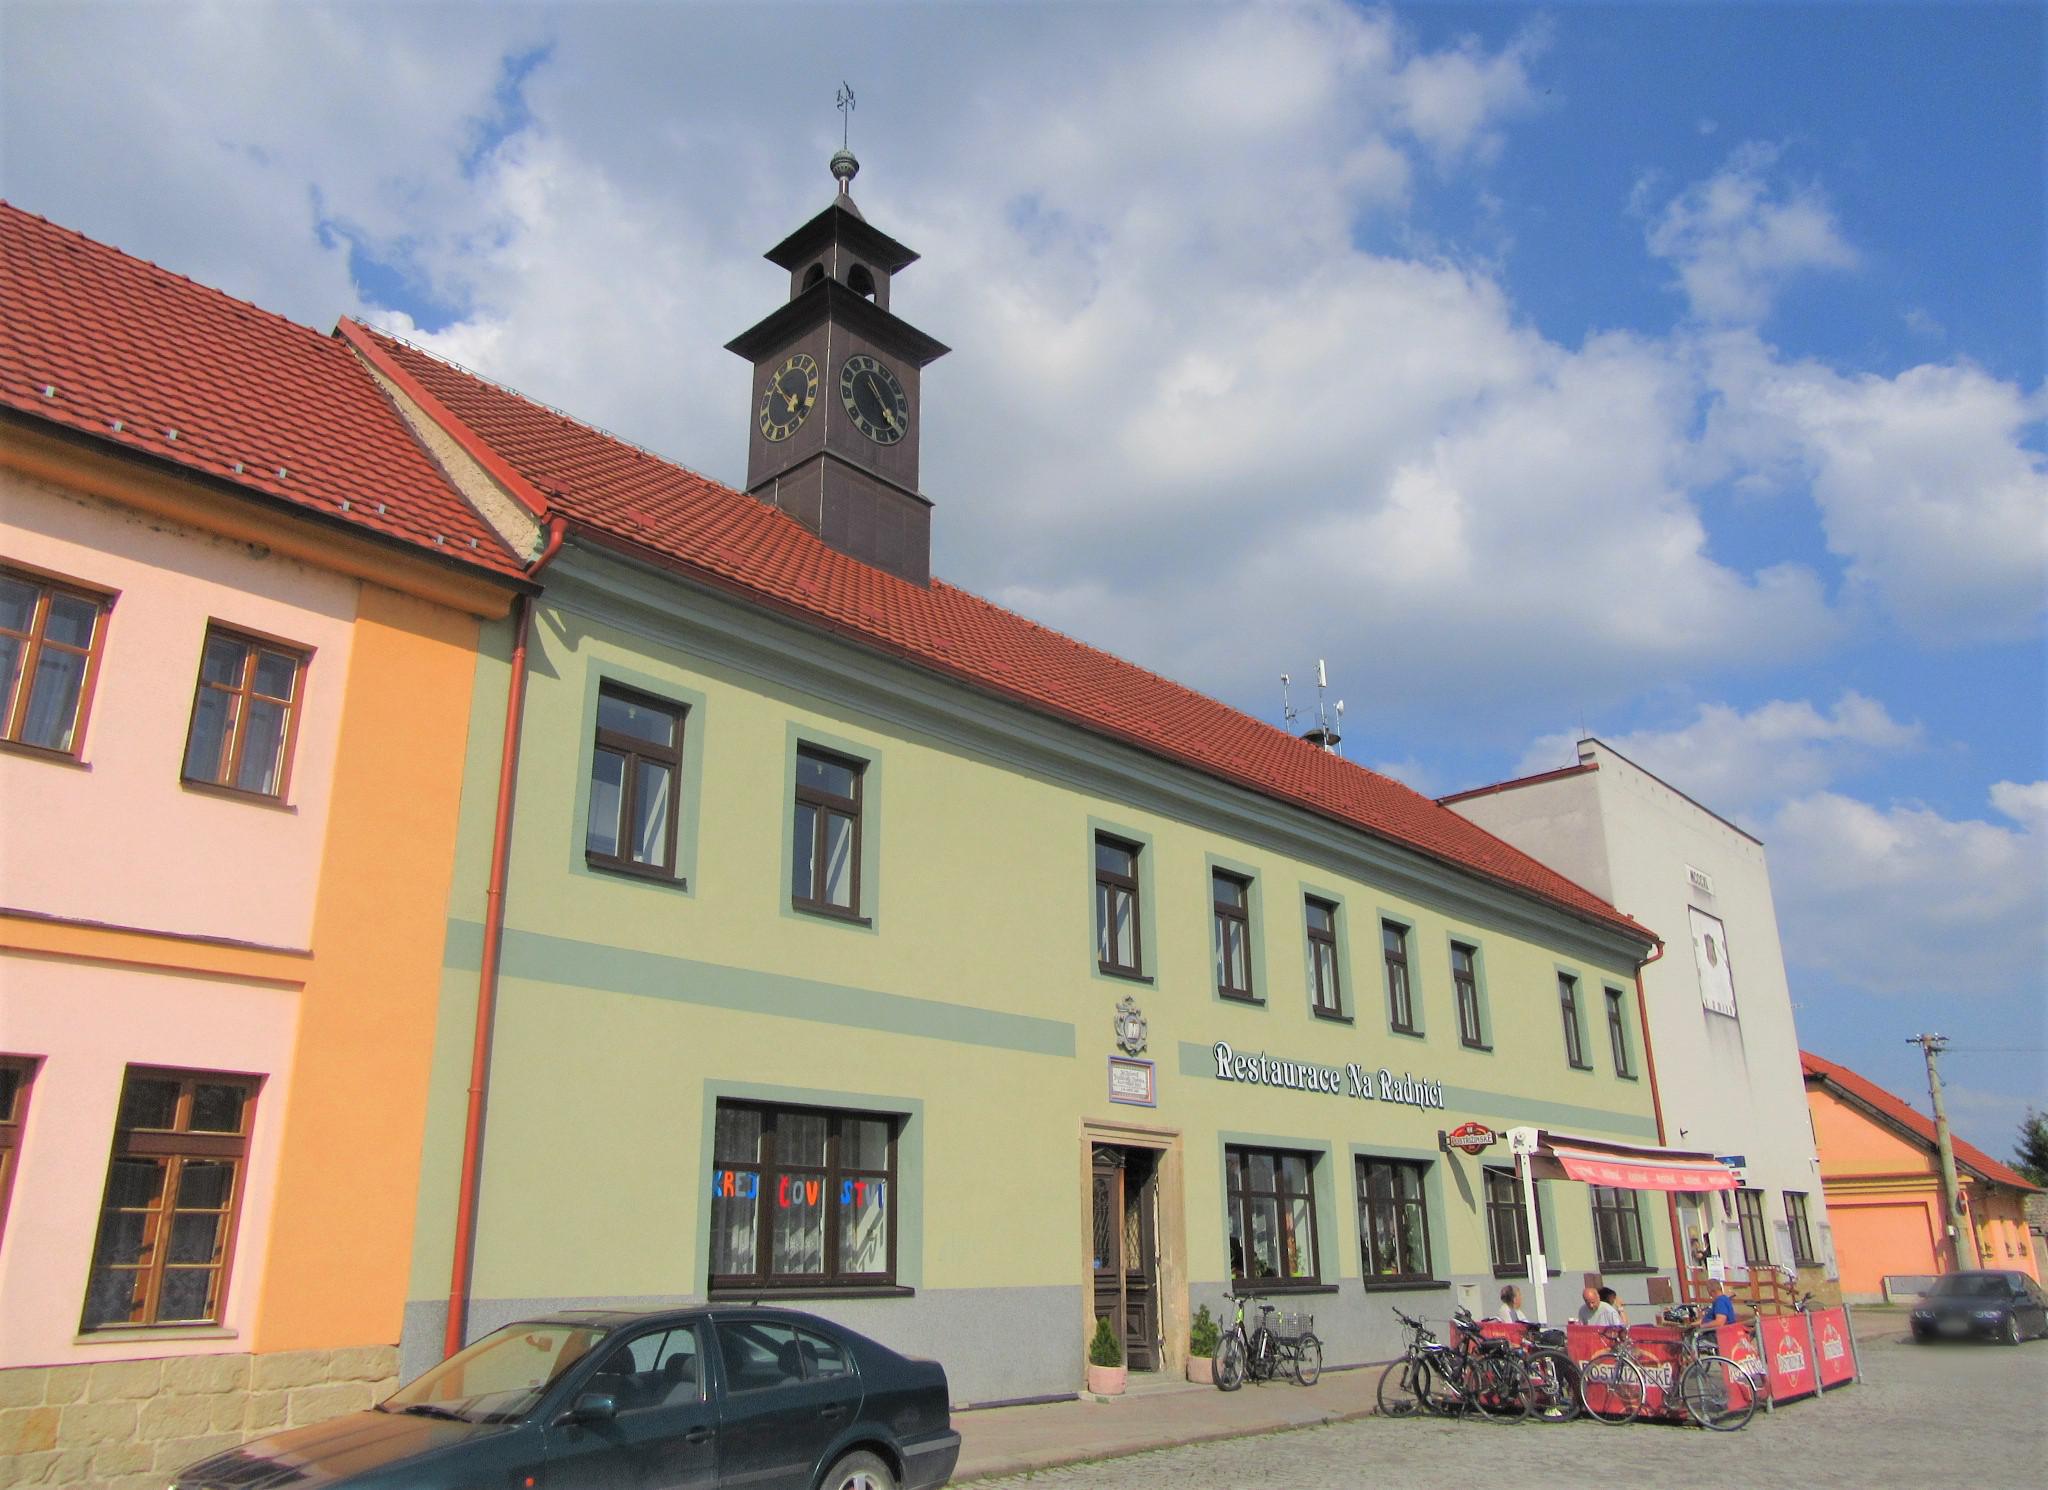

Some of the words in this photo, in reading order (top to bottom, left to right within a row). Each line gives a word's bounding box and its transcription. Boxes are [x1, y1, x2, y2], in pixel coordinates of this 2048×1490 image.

[1213, 1041, 1341, 1094] Restaurace
[1346, 1062, 1375, 1099] Na
[1377, 1068, 1445, 1113] Radnici
